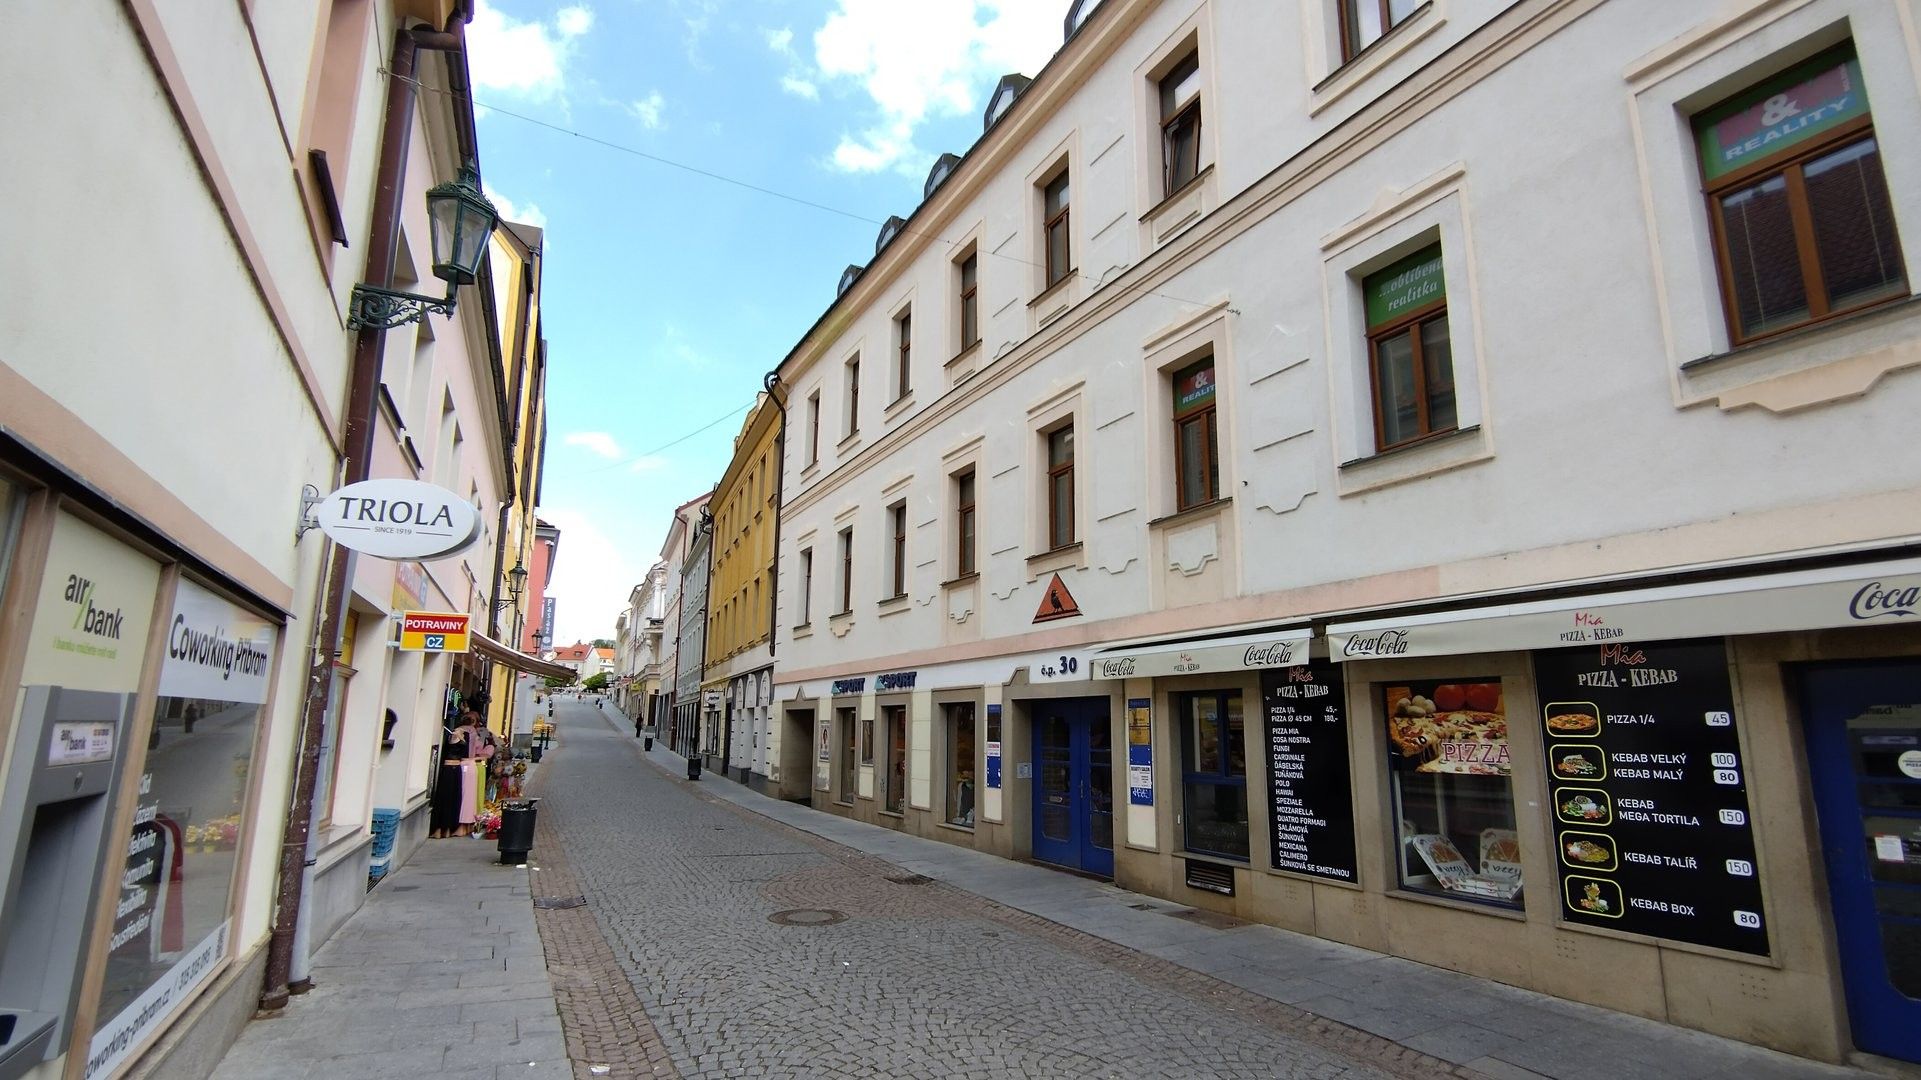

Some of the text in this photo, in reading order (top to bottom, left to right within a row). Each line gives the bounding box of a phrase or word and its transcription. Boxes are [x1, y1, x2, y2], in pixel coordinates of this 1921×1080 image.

[1725, 97, 1848, 160] REALITY
[1388, 280, 1438, 312] realitka
[1182, 384, 1215, 404] REALIT
[339, 497, 453, 527] TRIOLA
[374, 526, 412, 535] SINCE 1919
[64, 574, 91, 605] air
[83, 599, 123, 640] bank
[405, 619, 464, 630] POTRAVINY
[1575, 612, 1603, 627] Mia
[426, 636, 443, 648] CZ
[1560, 630, 1586, 641] PIZZA
[1593, 628, 1624, 640] KEBAB
[170, 613, 234, 681] Coworking
[1343, 630, 1410, 657] Coca-Cola
[1243, 642, 1294, 667] Coca-Cola
[1601, 643, 1647, 666] Mia
[1059, 656, 1077, 674] 30
[1103, 656, 1136, 677] Coca-Cola
[885, 672, 917, 689] SPORT
[1288, 666, 1313, 682] Mia
[1578, 670, 1619, 688] PIZZA
[1629, 668, 1678, 687] KEBAB
[1277, 686, 1298, 698] PIZZA
[1304, 684, 1329, 698] KEBAB
[1607, 714, 1655, 725] PIZZA 1/4
[1712, 714, 1728, 724] 45
[1442, 743, 1511, 764] PIZZA
[1612, 752, 1687, 764] KEBAB VELKÝ
[1715, 754, 1734, 765] 100
[1614, 768, 1683, 780] KEBAB MALÝ
[1720, 772, 1735, 781] 80
[1276, 797, 1303, 806] SPEZIALE
[1617, 798, 1654, 809] KEBAB
[1276, 806, 1314, 816] MOZZARELLA
[1619, 811, 1700, 826] MEGA TORTILA
[1721, 811, 1743, 823] 150
[1279, 842, 1308, 852] MEXICANA
[1624, 852, 1697, 869] KEBAB TALÍŘ
[1728, 862, 1750, 873] 150
[1307, 863, 1315, 871] SE
[1316, 865, 1350, 877] SMETANOU
[1630, 897, 1695, 916] KEBAB BOX
[1740, 914, 1757, 924] 80
